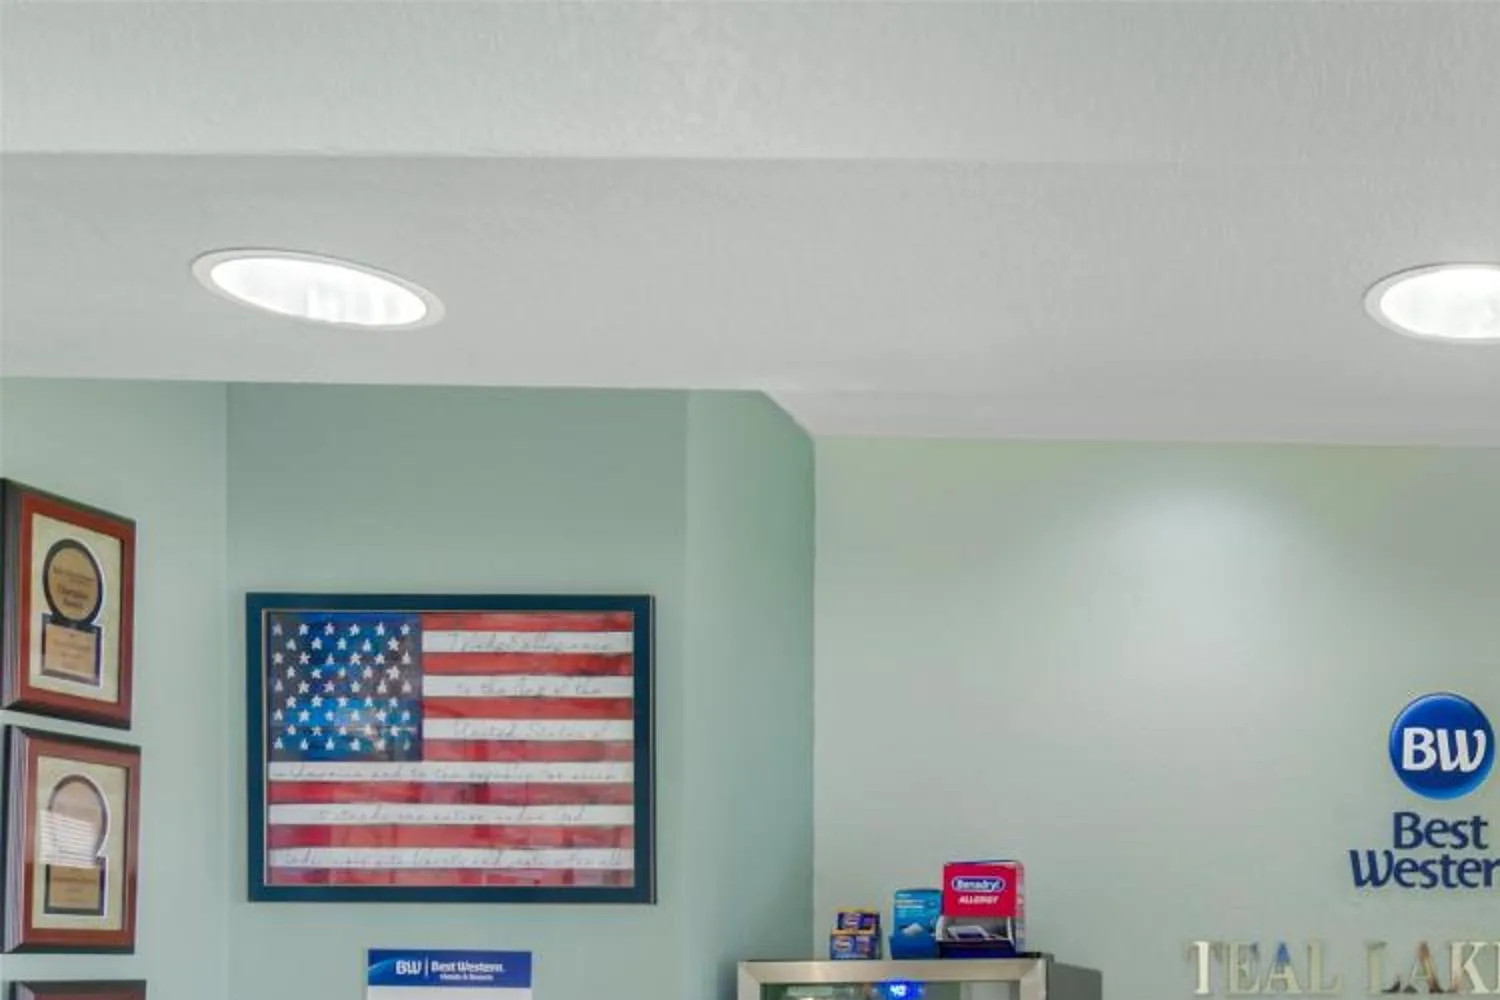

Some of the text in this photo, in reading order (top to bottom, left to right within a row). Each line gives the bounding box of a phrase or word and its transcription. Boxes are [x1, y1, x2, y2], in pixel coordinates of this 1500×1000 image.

[1402, 726, 1487, 773] BW
[1393, 811, 1489, 850] Best
[957, 877, 1001, 891] Benadryl
[958, 895, 999, 905] ALLERGY
[395, 959, 504, 975] BW Best Western
[1187, 939, 1343, 995] TEAL
